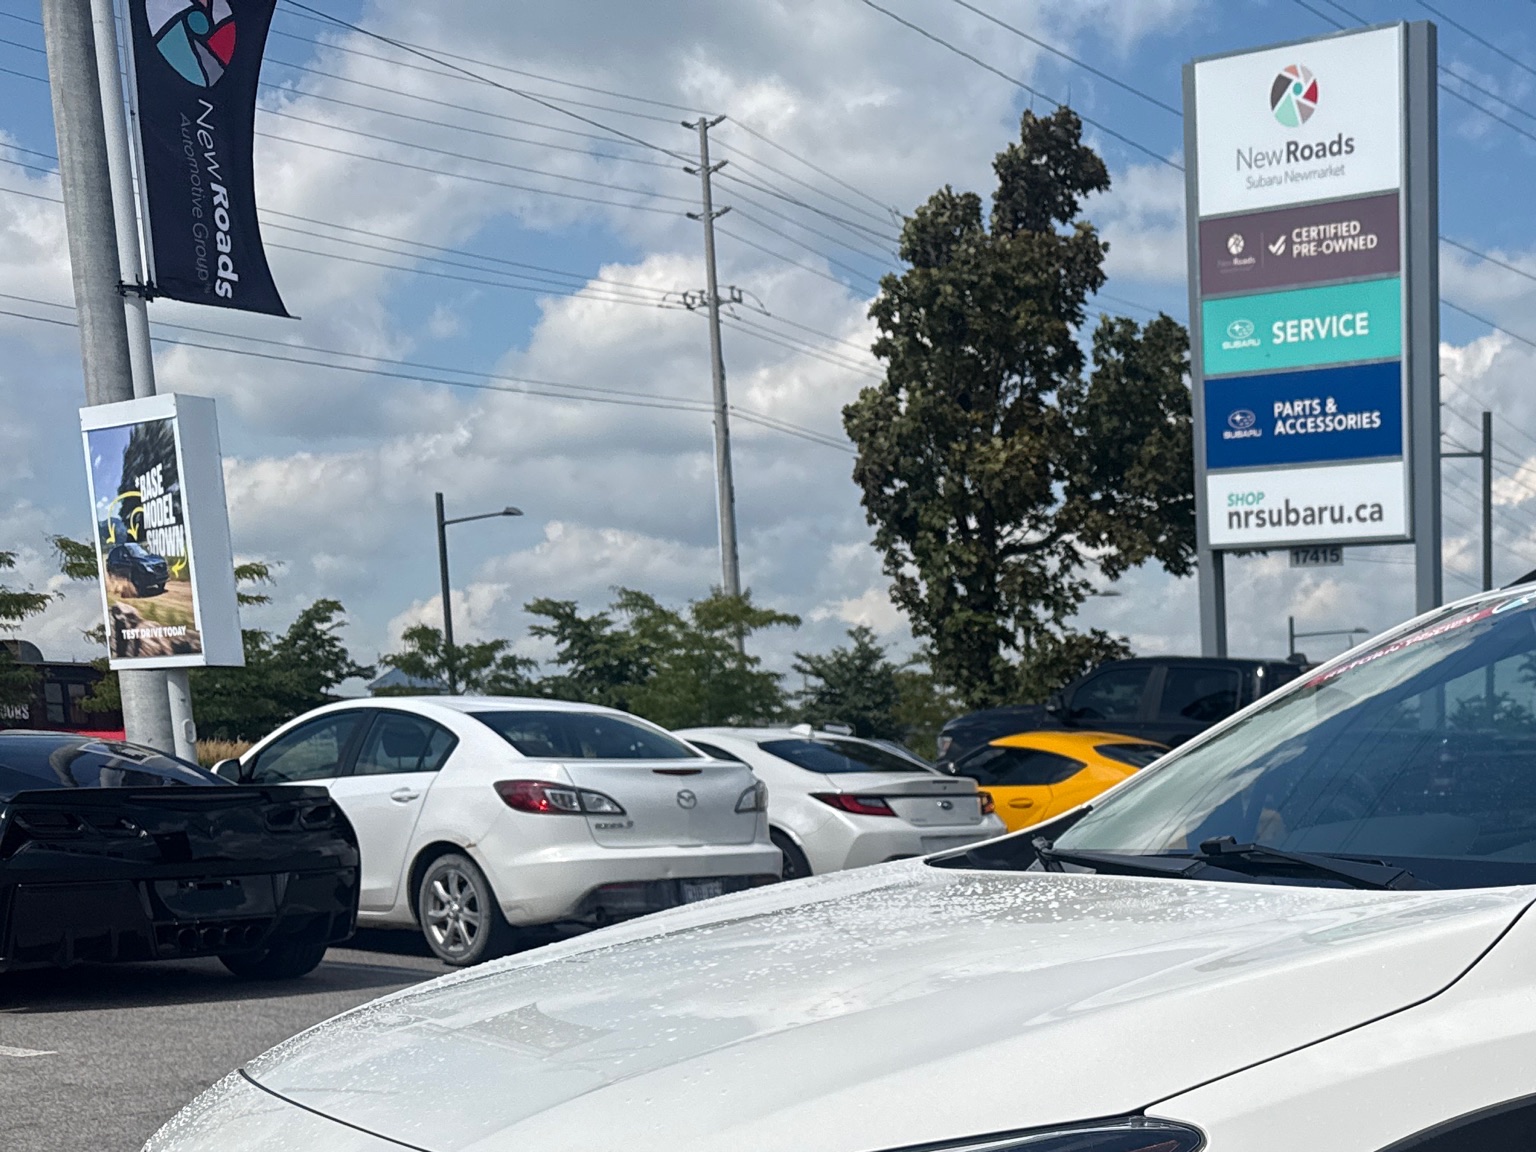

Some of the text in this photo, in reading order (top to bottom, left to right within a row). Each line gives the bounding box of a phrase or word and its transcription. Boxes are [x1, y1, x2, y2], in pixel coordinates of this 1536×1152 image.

[1246, 164, 1346, 190] Subaru Newmarket
[179, 112, 204, 219] Automotive
[192, 223, 209, 281] Group
[1291, 220, 1361, 244] CERTIFIED
[1292, 234, 1378, 259] PRE-OWNED
[1222, 312, 1370, 350] SUBARU SERVICE
[1273, 396, 1338, 418] PARTS &
[1222, 428, 1262, 440] SUBARU
[1273, 411, 1382, 436] ACCESSORIES
[143, 493, 176, 530] MODEL
[1227, 491, 1266, 507] SHOP
[1228, 499, 1384, 530] nrsubaru.ca
[146, 524, 185, 557] SHOWN
[1293, 549, 1340, 565] 17415
[121, 625, 187, 640] TEST DRIVE TODAY
